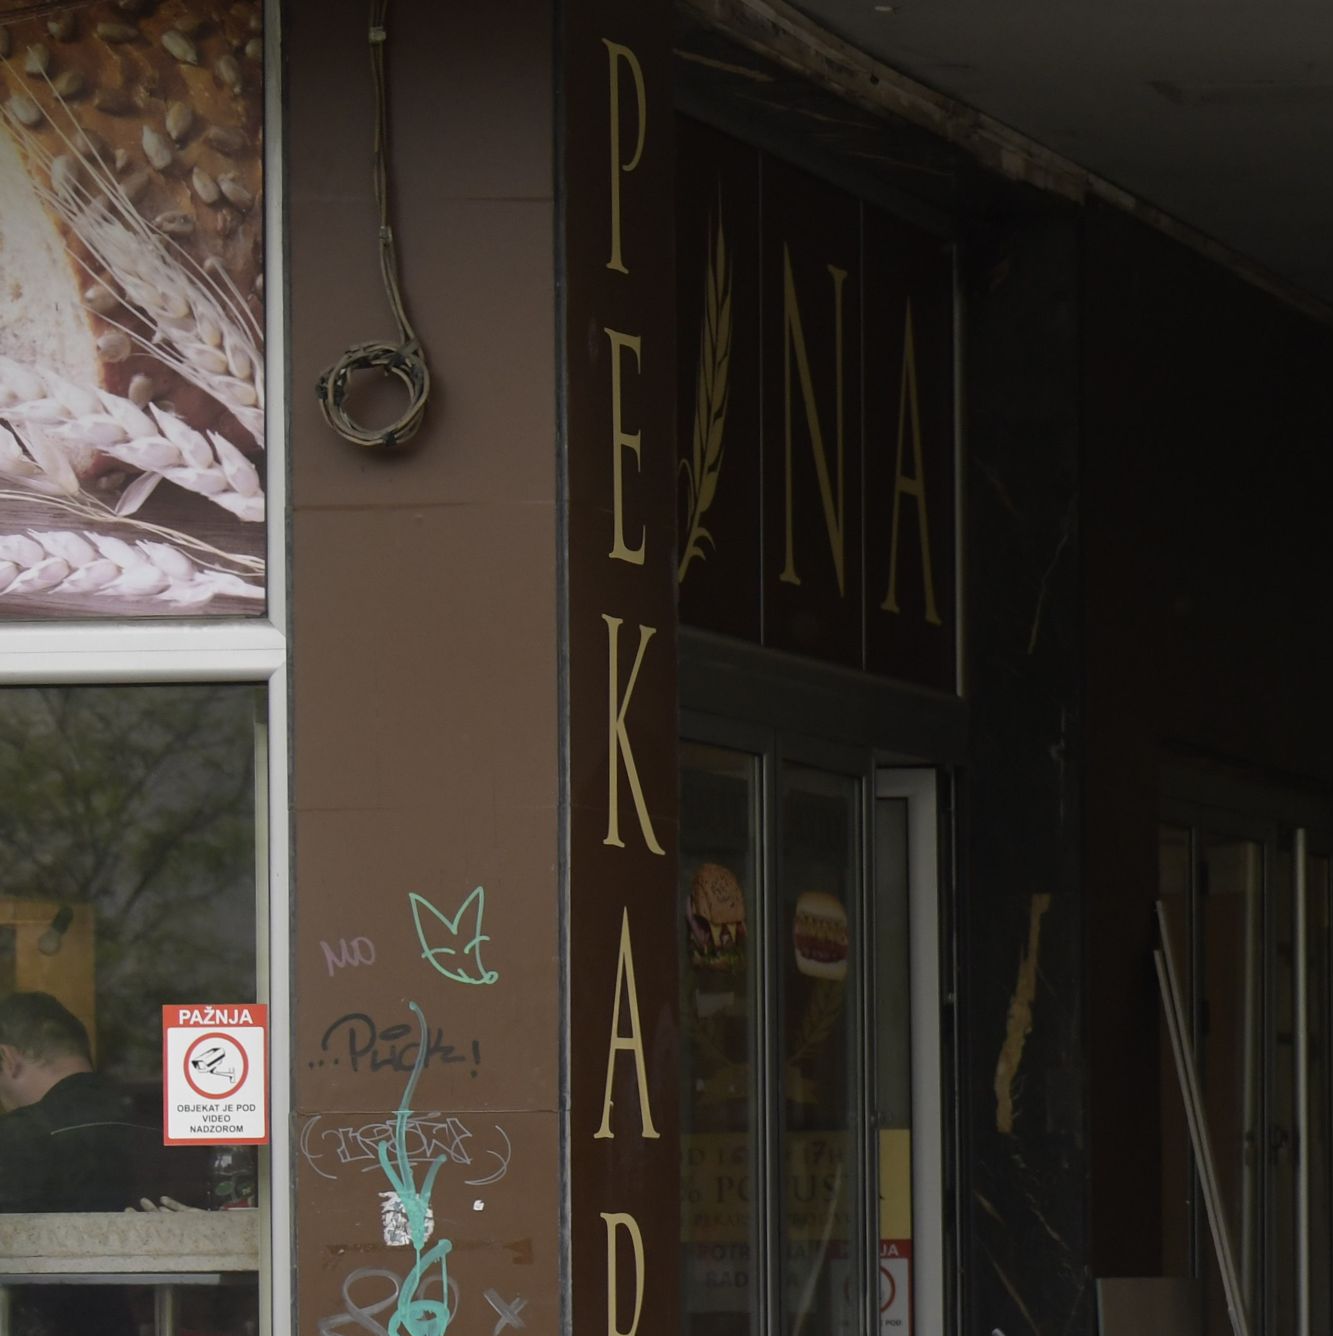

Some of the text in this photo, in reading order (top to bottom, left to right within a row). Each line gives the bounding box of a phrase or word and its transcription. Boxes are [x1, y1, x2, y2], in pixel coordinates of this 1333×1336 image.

[178, 1005, 254, 1025] PAŽNJA
[177, 1103, 256, 1113] OBJEKAT JE POD
[202, 1114, 231, 1122] VIDEO
[190, 1125, 244, 1133] NADZOROM
